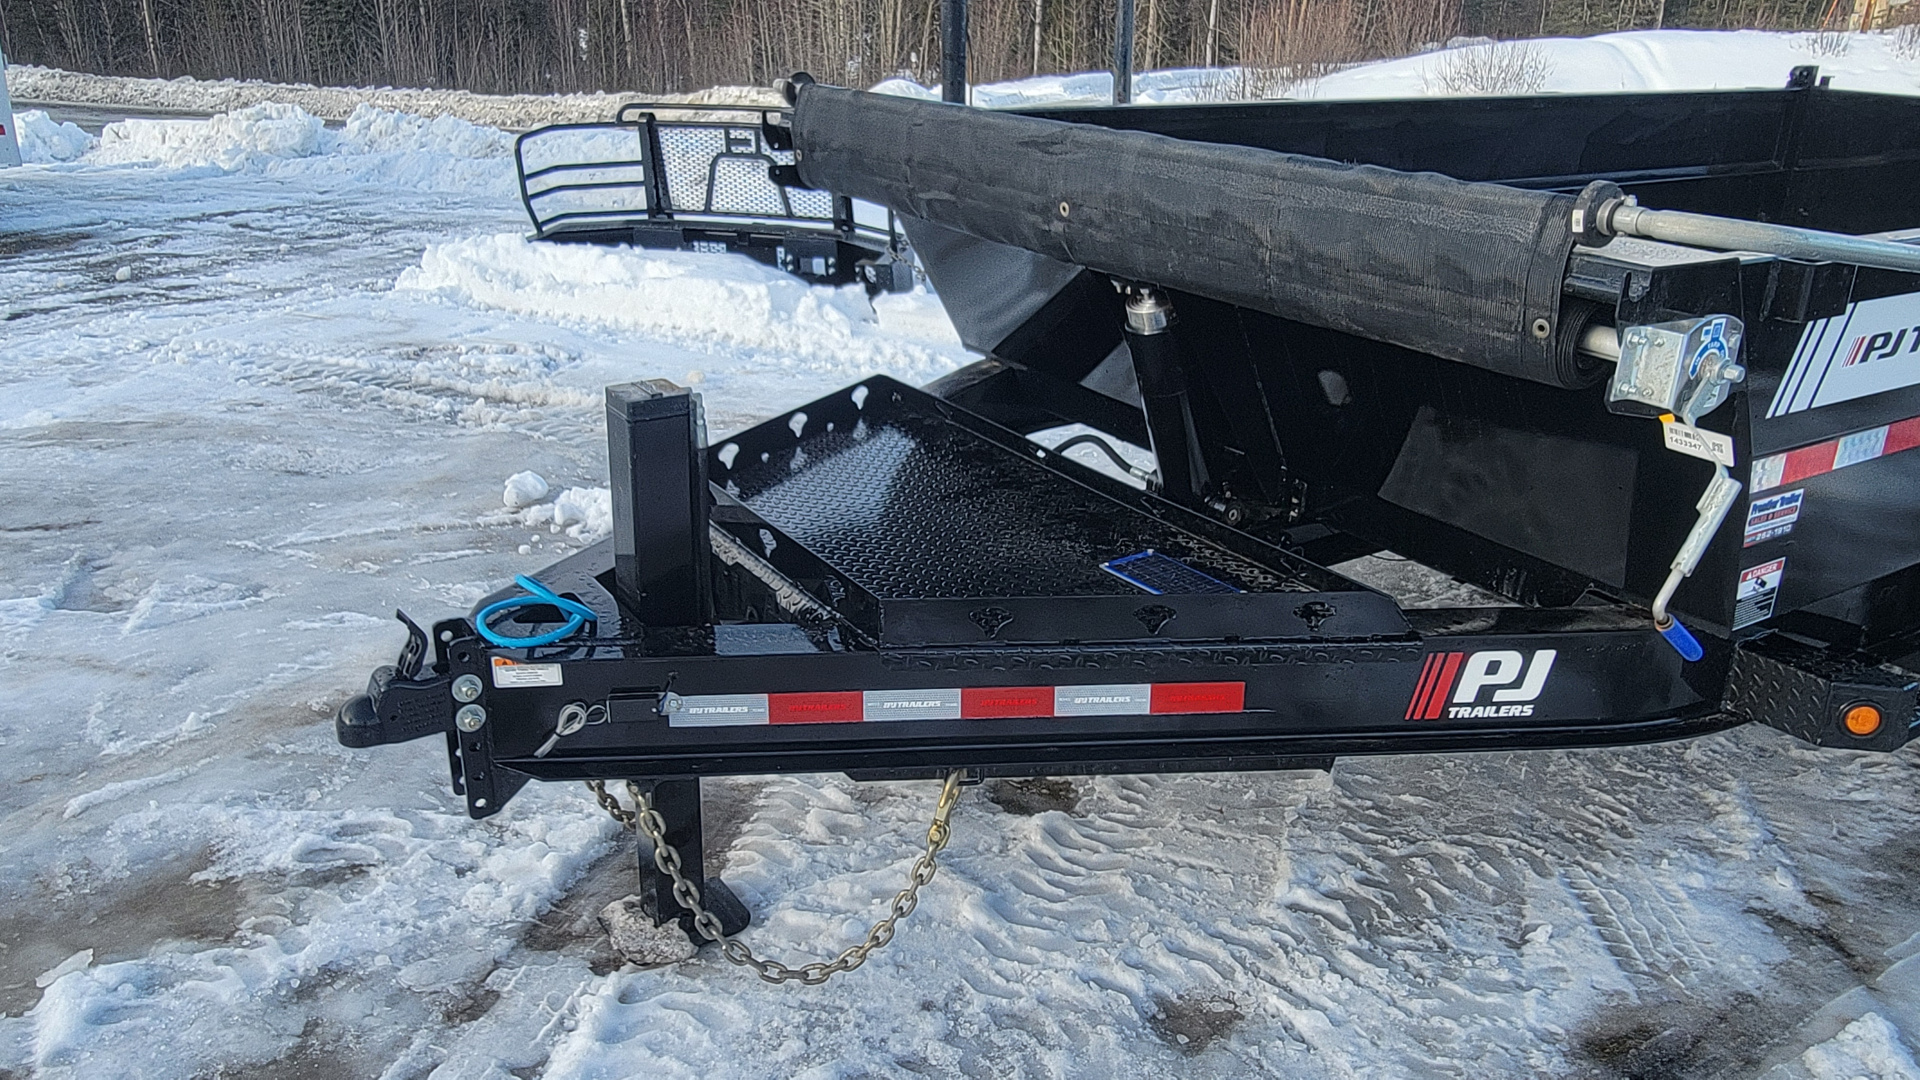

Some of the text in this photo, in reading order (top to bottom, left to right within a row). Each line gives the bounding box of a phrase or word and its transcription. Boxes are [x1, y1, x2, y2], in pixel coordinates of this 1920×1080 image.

[1858, 328, 1908, 364] PJ
[1752, 563, 1779, 577] DANGER
[1453, 649, 1557, 703] PJ
[1448, 704, 1534, 719] TRAILERS
